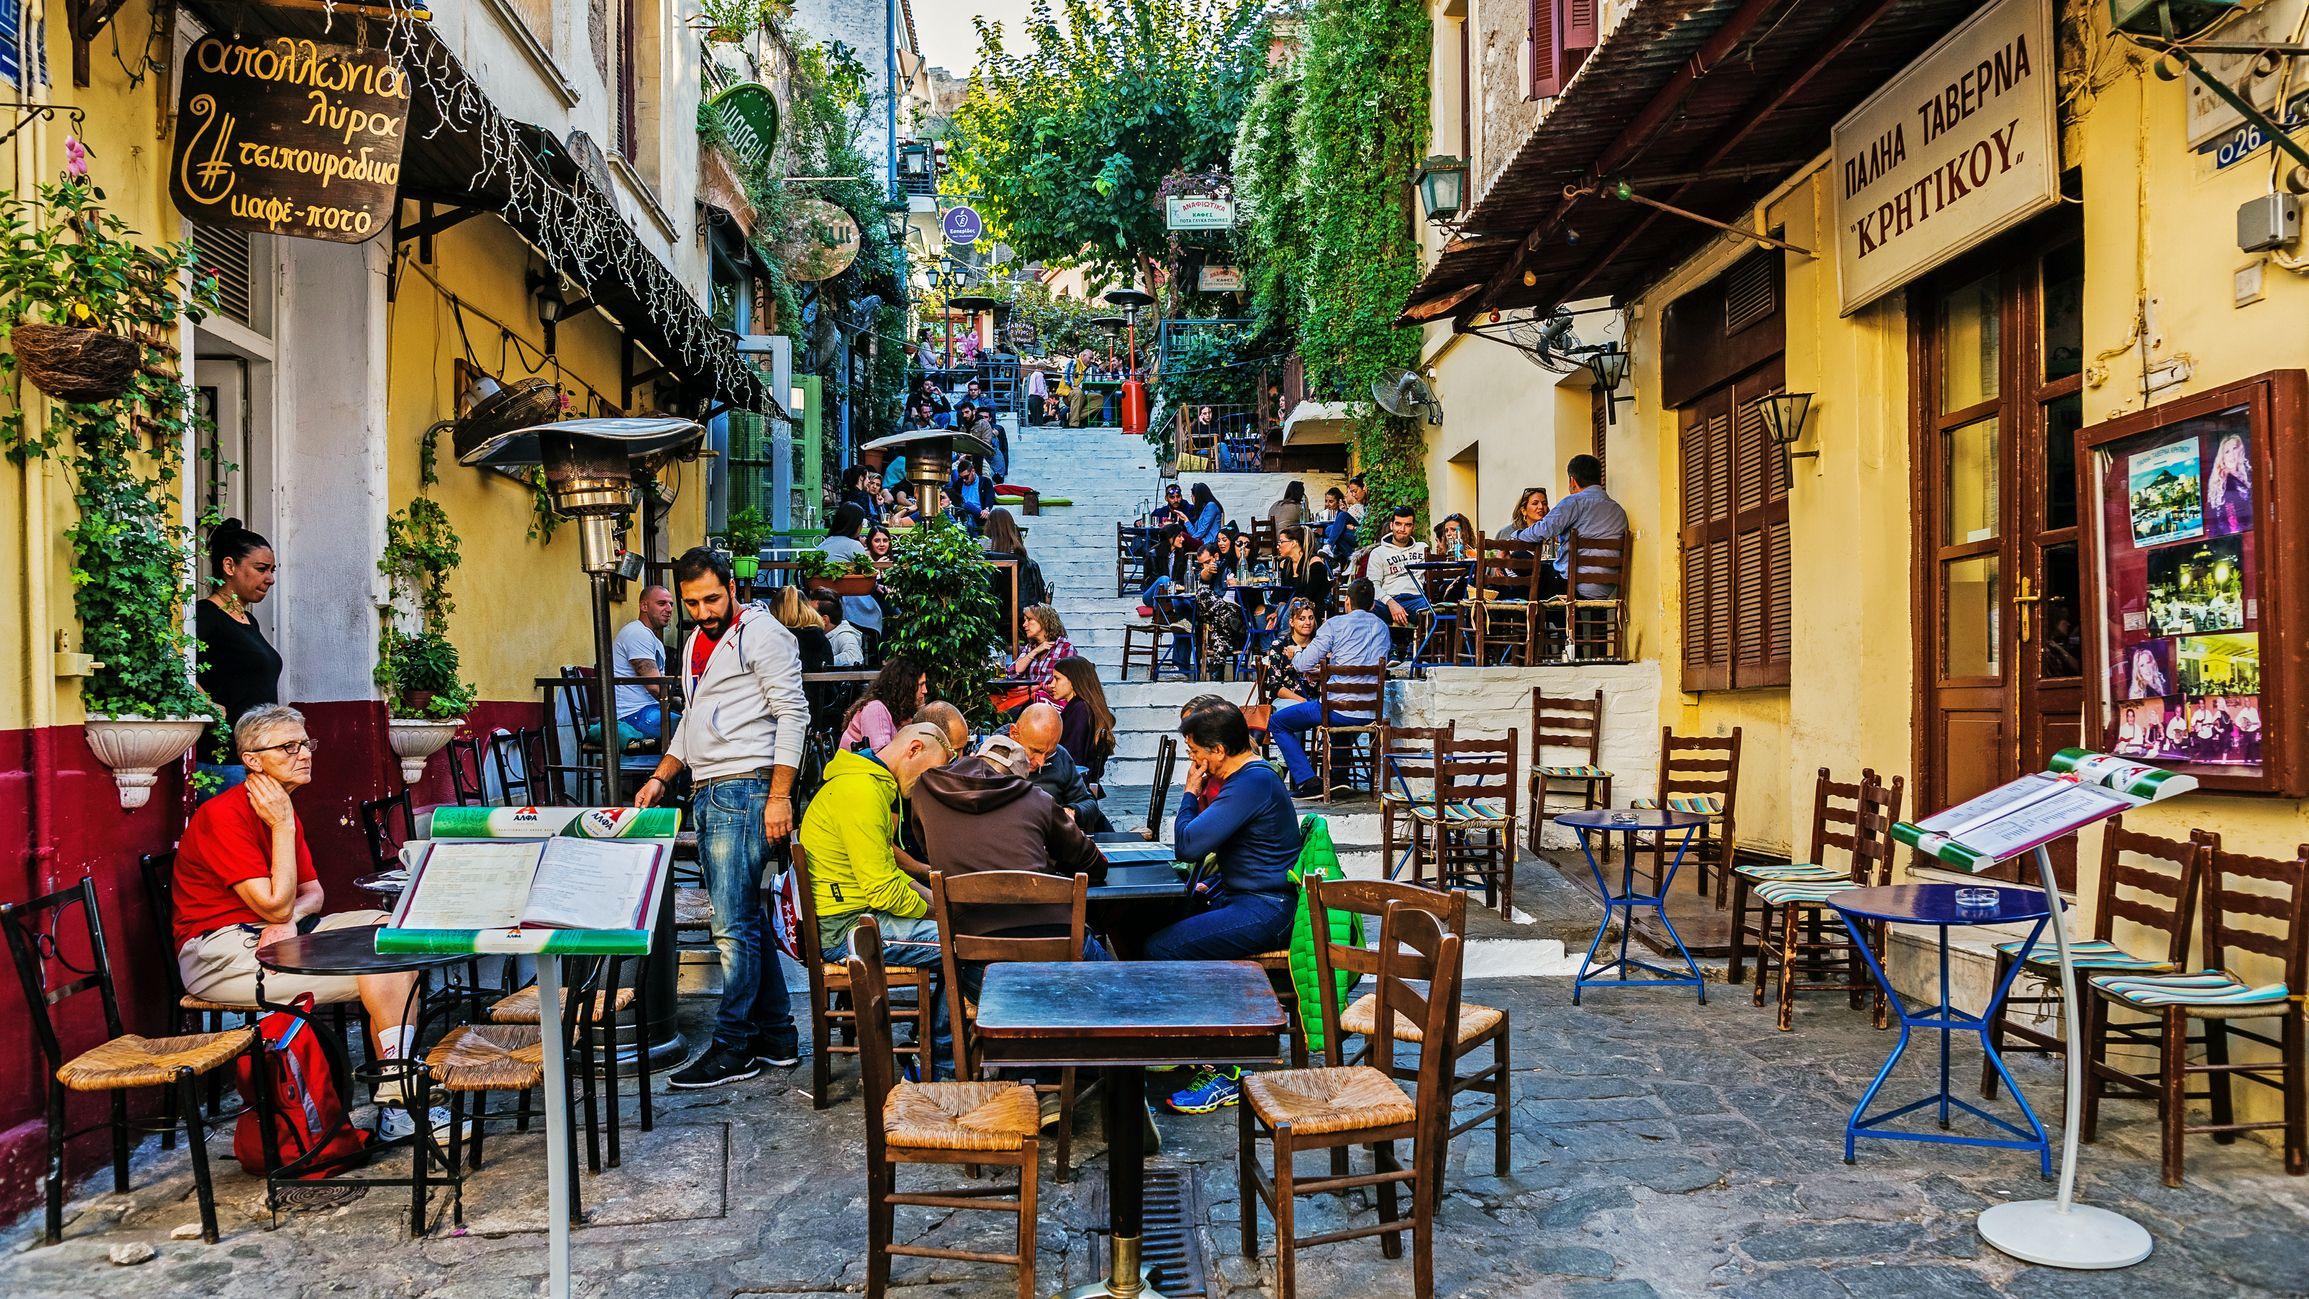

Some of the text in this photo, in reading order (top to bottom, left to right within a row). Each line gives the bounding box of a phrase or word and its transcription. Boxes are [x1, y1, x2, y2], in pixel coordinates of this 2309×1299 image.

[302, 91, 401, 145] λύρα
[1845, 33, 2032, 201] ΠΑΛΗΑ ΤΑΒΕΡΝΑ
[231, 194, 372, 235] καφέ-ποτό
[1182, 201, 1226, 212] ΑΝΑΦΙΩΤΙΚΑ
